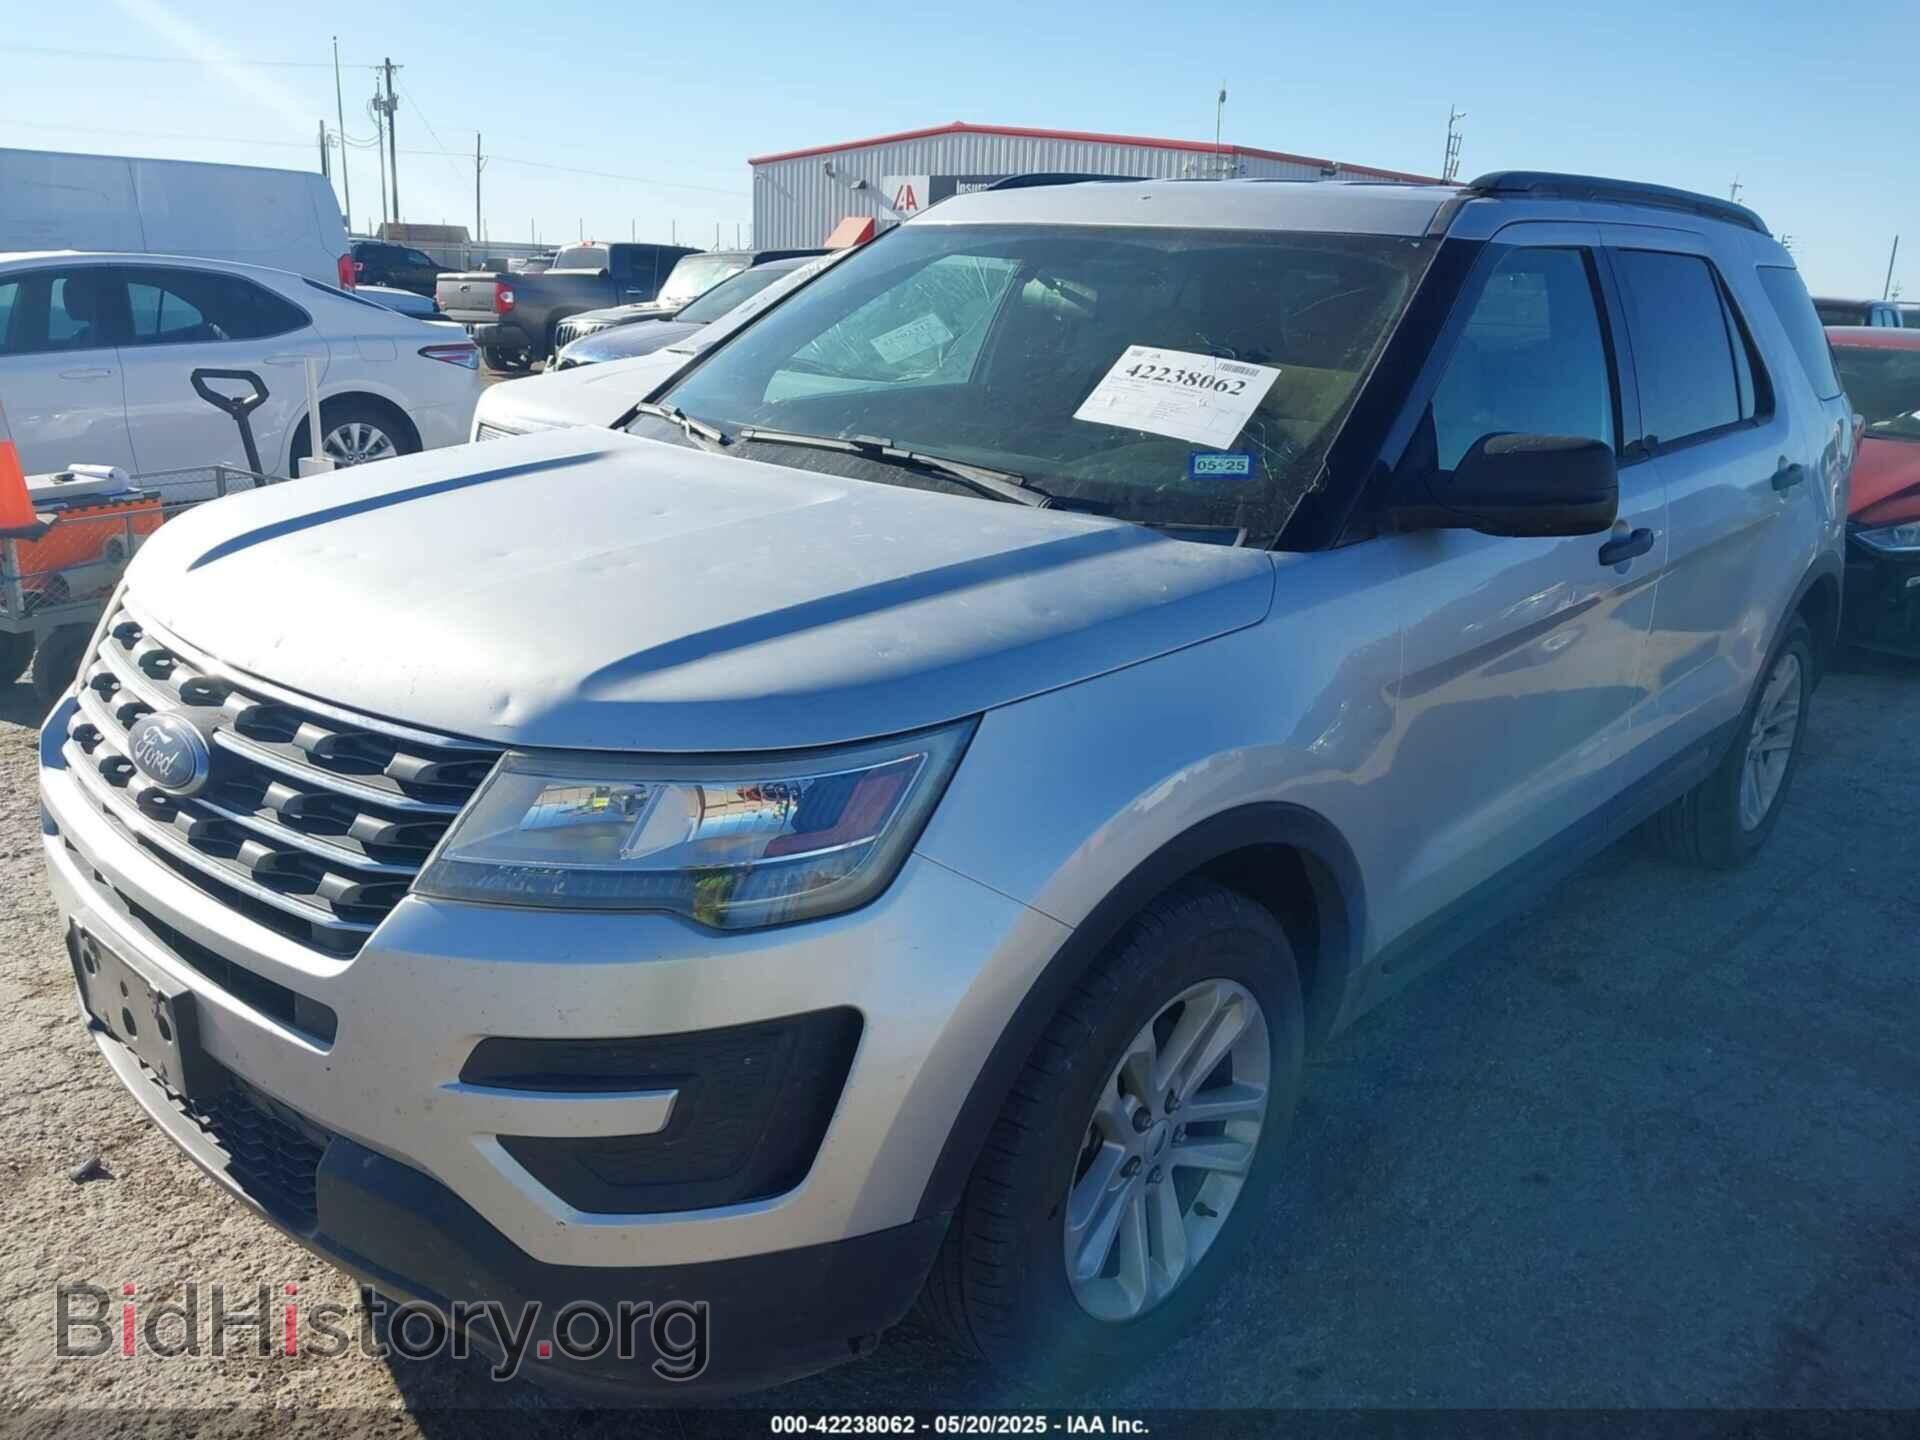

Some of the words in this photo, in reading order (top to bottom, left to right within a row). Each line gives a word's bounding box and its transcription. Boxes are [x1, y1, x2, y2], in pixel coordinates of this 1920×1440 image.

[1125, 363, 1247, 396] 42238062
[1196, 460, 1217, 471] 05
[1225, 460, 1246, 471] 25
[135, 726, 180, 776] Ford
